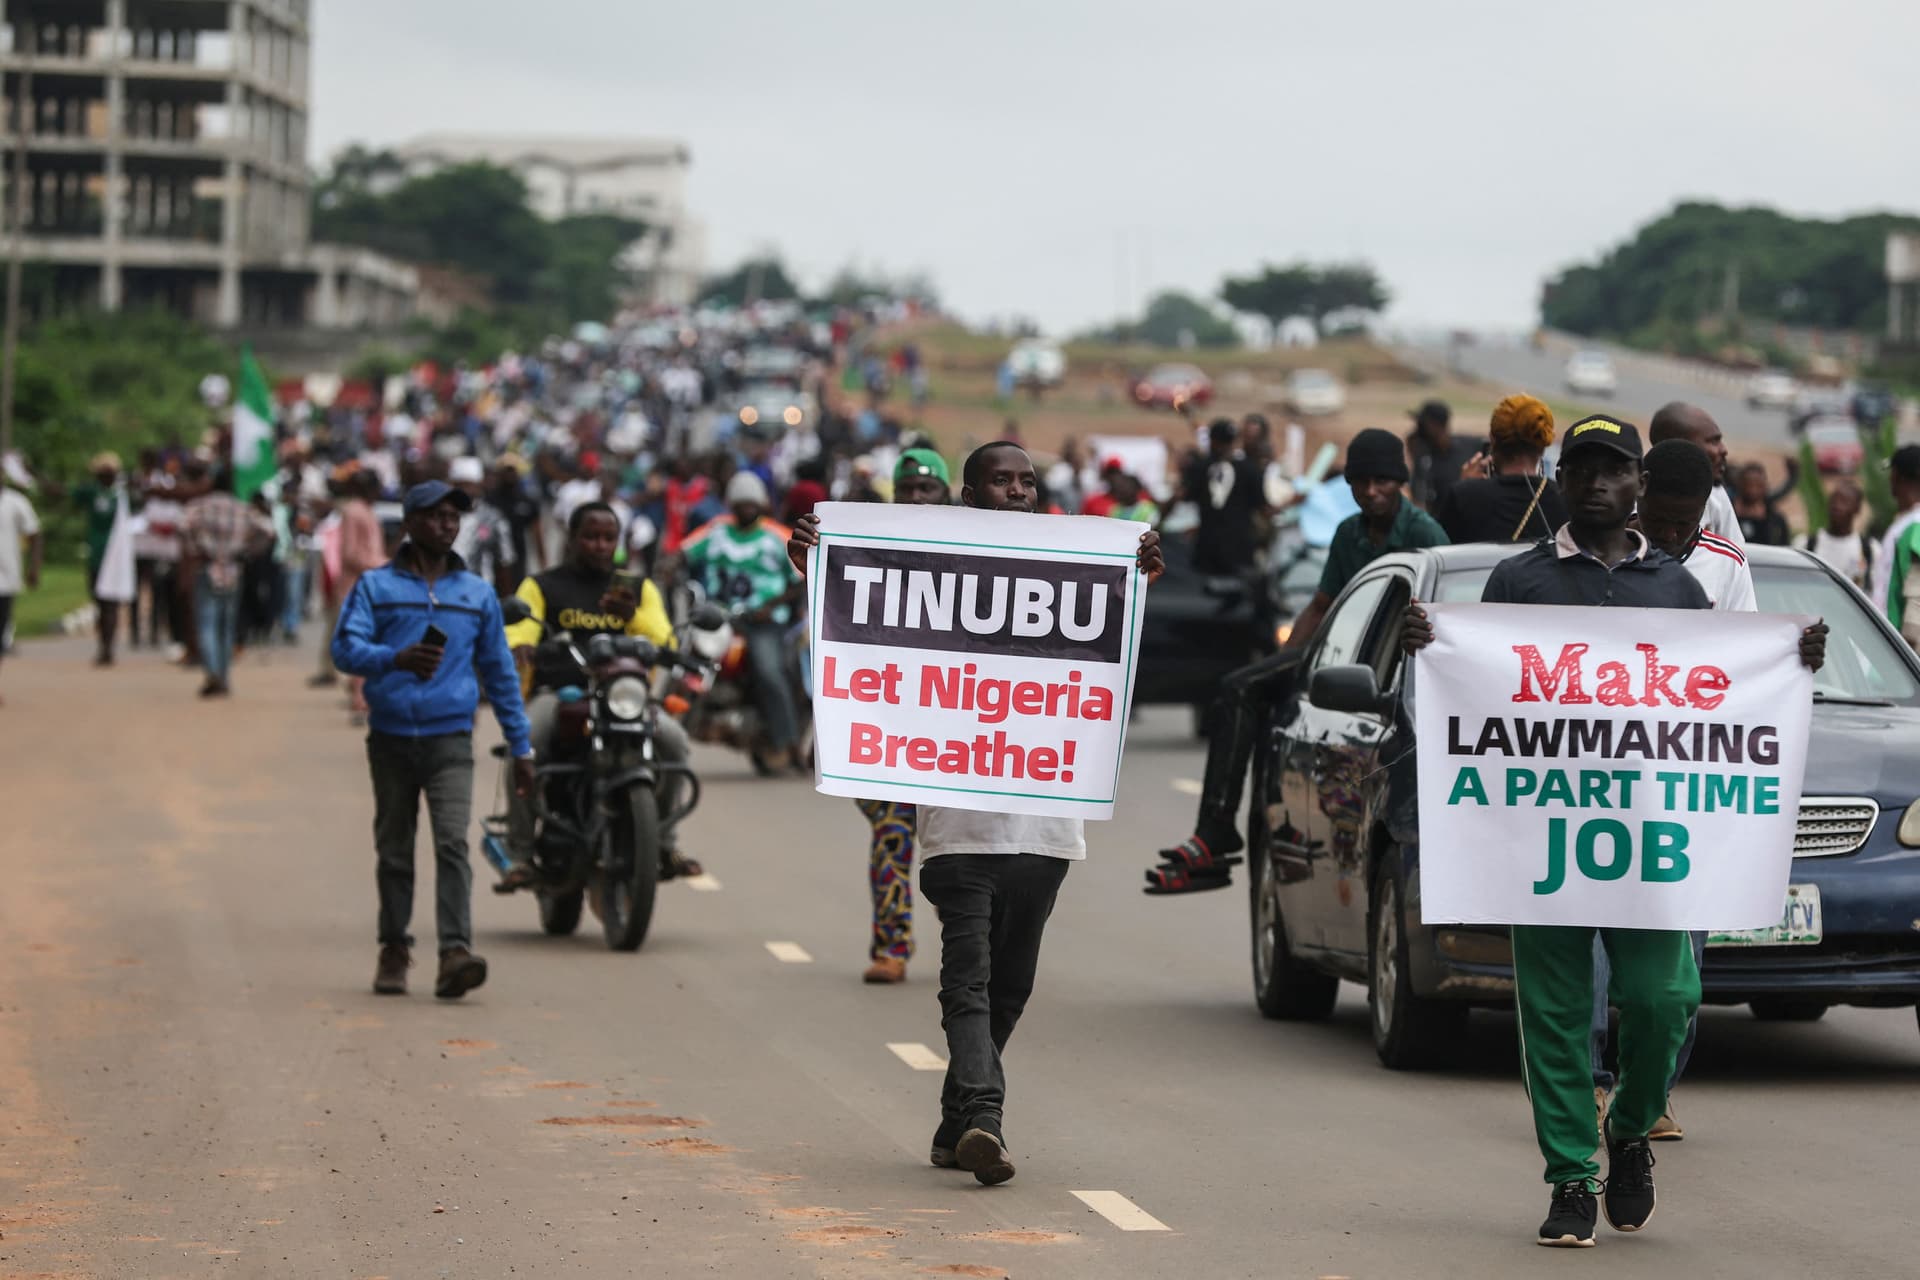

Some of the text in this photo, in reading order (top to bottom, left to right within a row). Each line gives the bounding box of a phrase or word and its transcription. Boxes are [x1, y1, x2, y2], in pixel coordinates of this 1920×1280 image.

[558, 607, 625, 630] Glovo
[843, 564, 1108, 642] TINUBU
[822, 656, 1114, 724] Let Nigeria
[1511, 642, 1731, 711] Make
[849, 722, 1077, 783] Breathe!
[1447, 715, 1780, 766] LAWMAKING
[1447, 766, 1780, 815] A PART TIME
[1533, 817, 1691, 895] JOB
